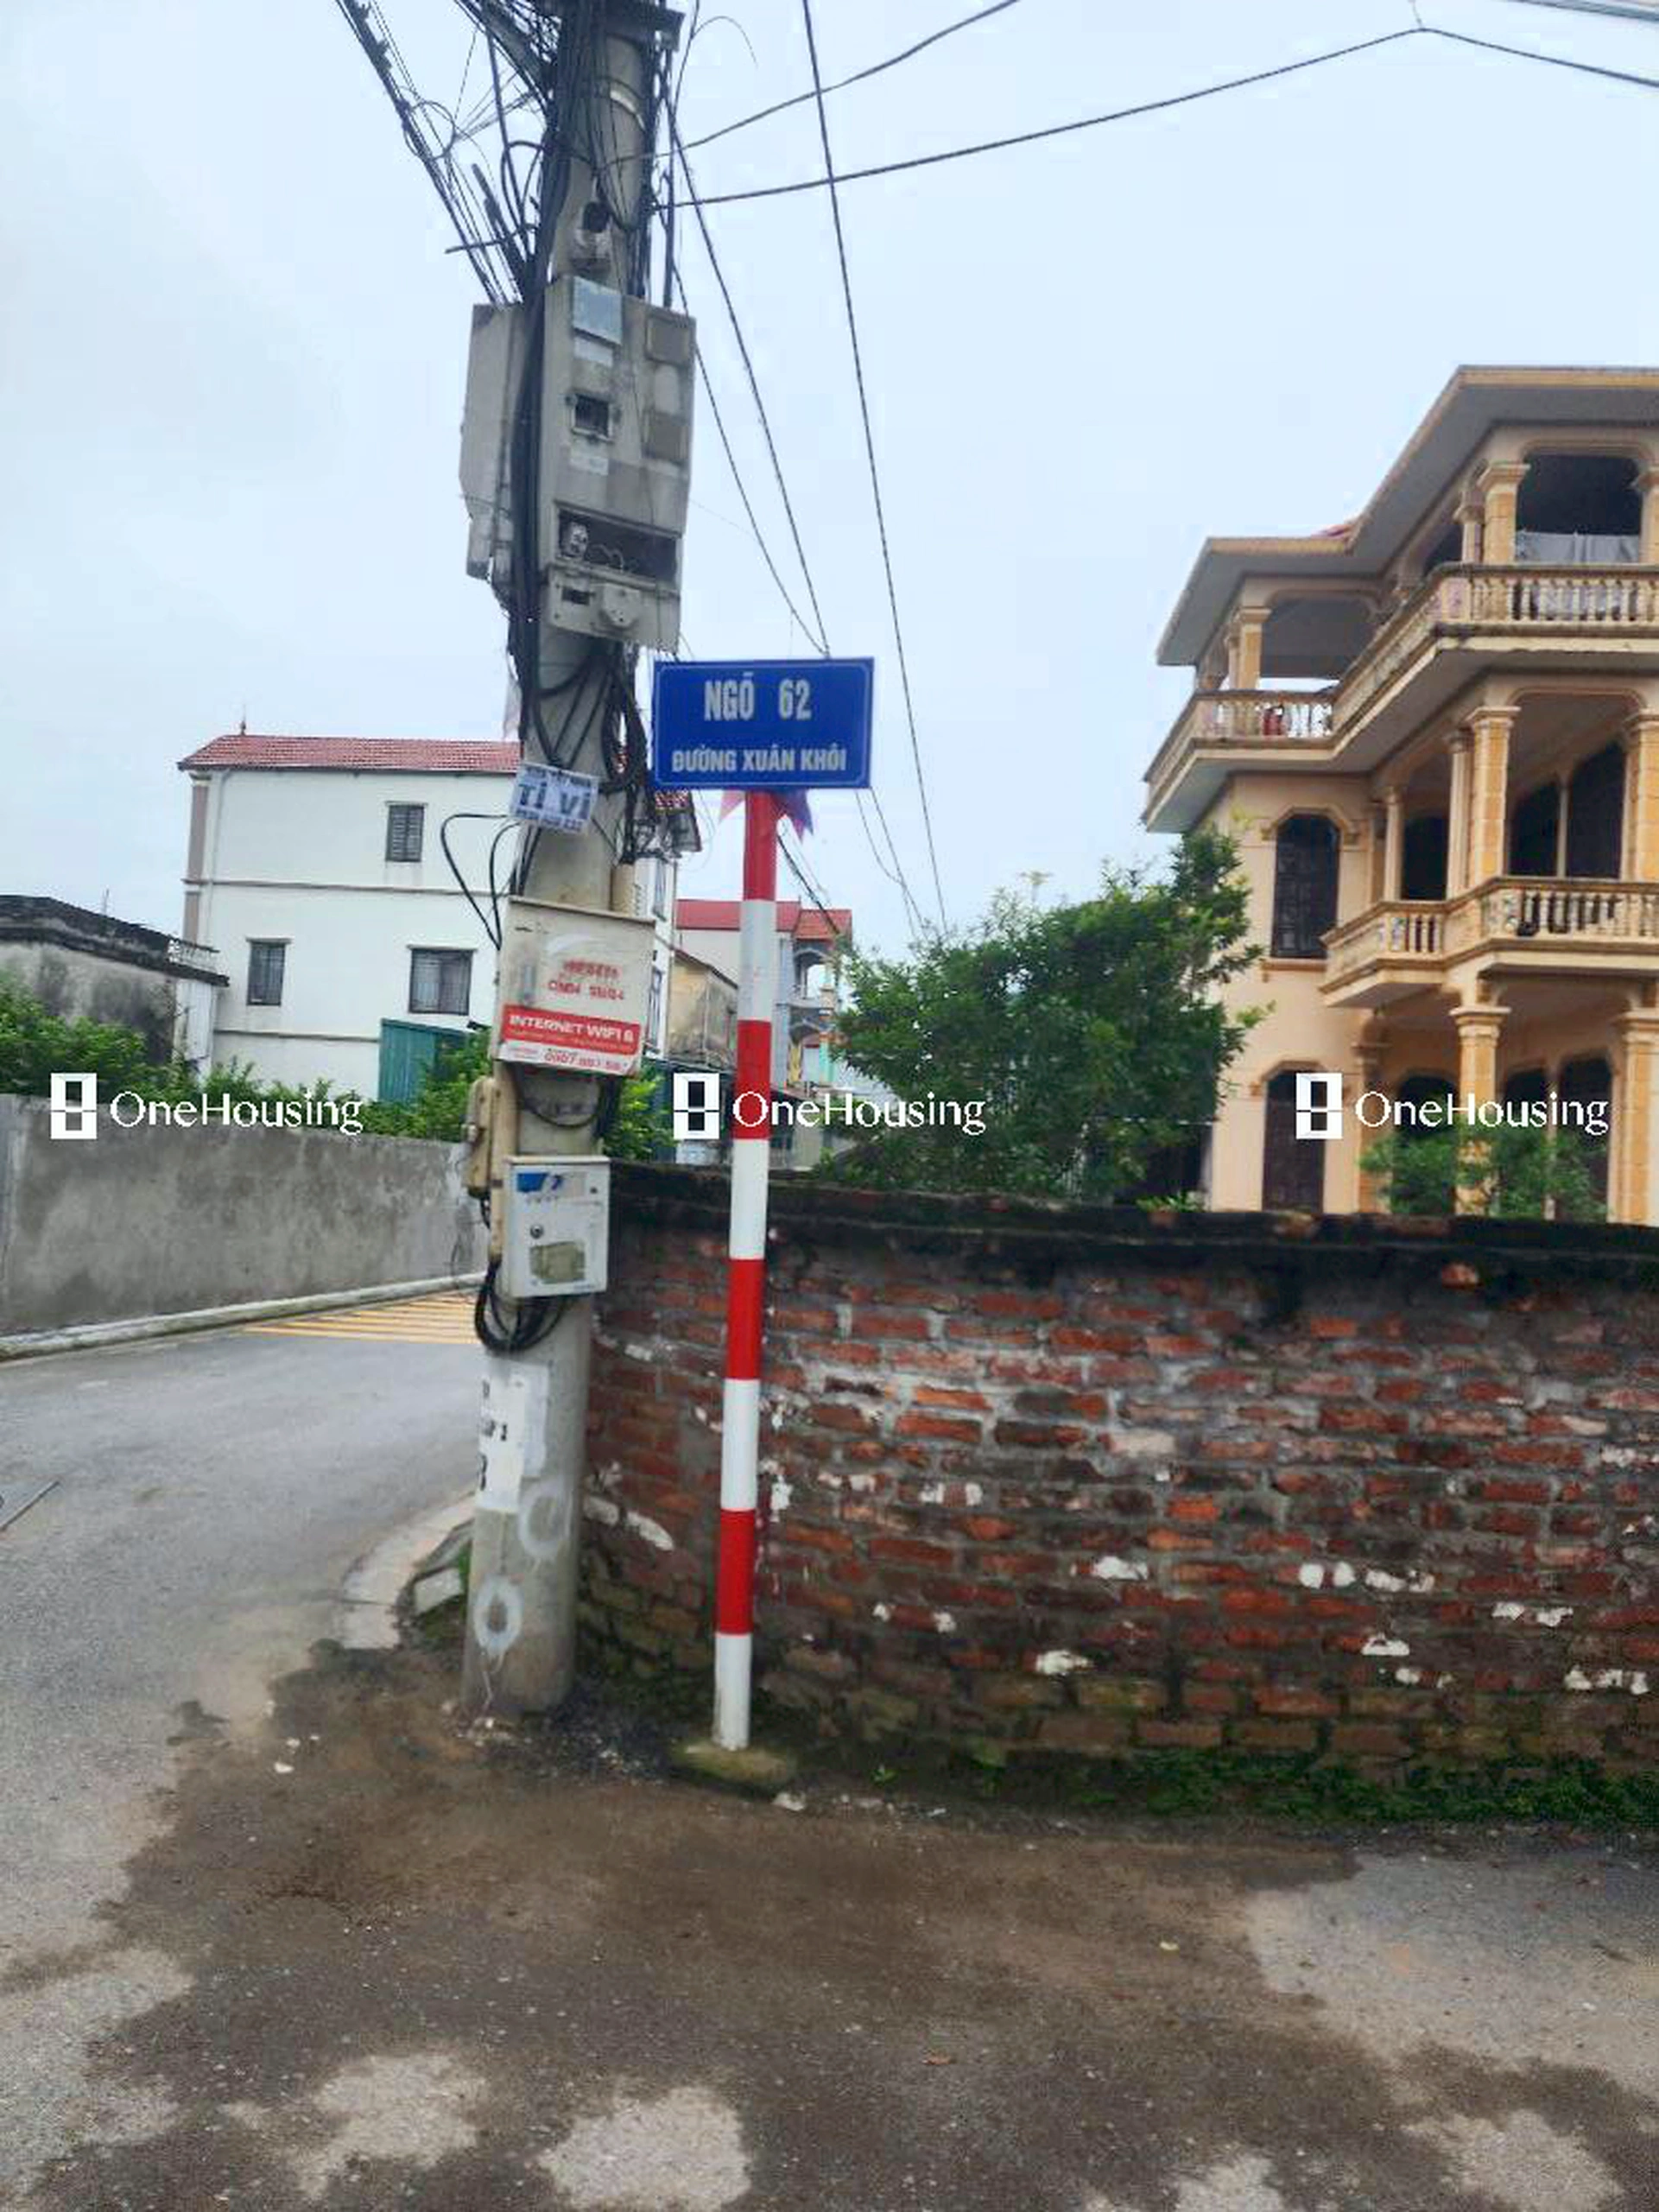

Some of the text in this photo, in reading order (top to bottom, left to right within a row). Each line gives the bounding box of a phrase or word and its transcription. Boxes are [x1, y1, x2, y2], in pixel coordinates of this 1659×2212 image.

[704, 672, 812, 721] NGÕ 62
[671, 745, 737, 772] ĐƯỜNG
[742, 744, 795, 771] XUÂN
[510, 1015, 583, 1034] INTERNET
